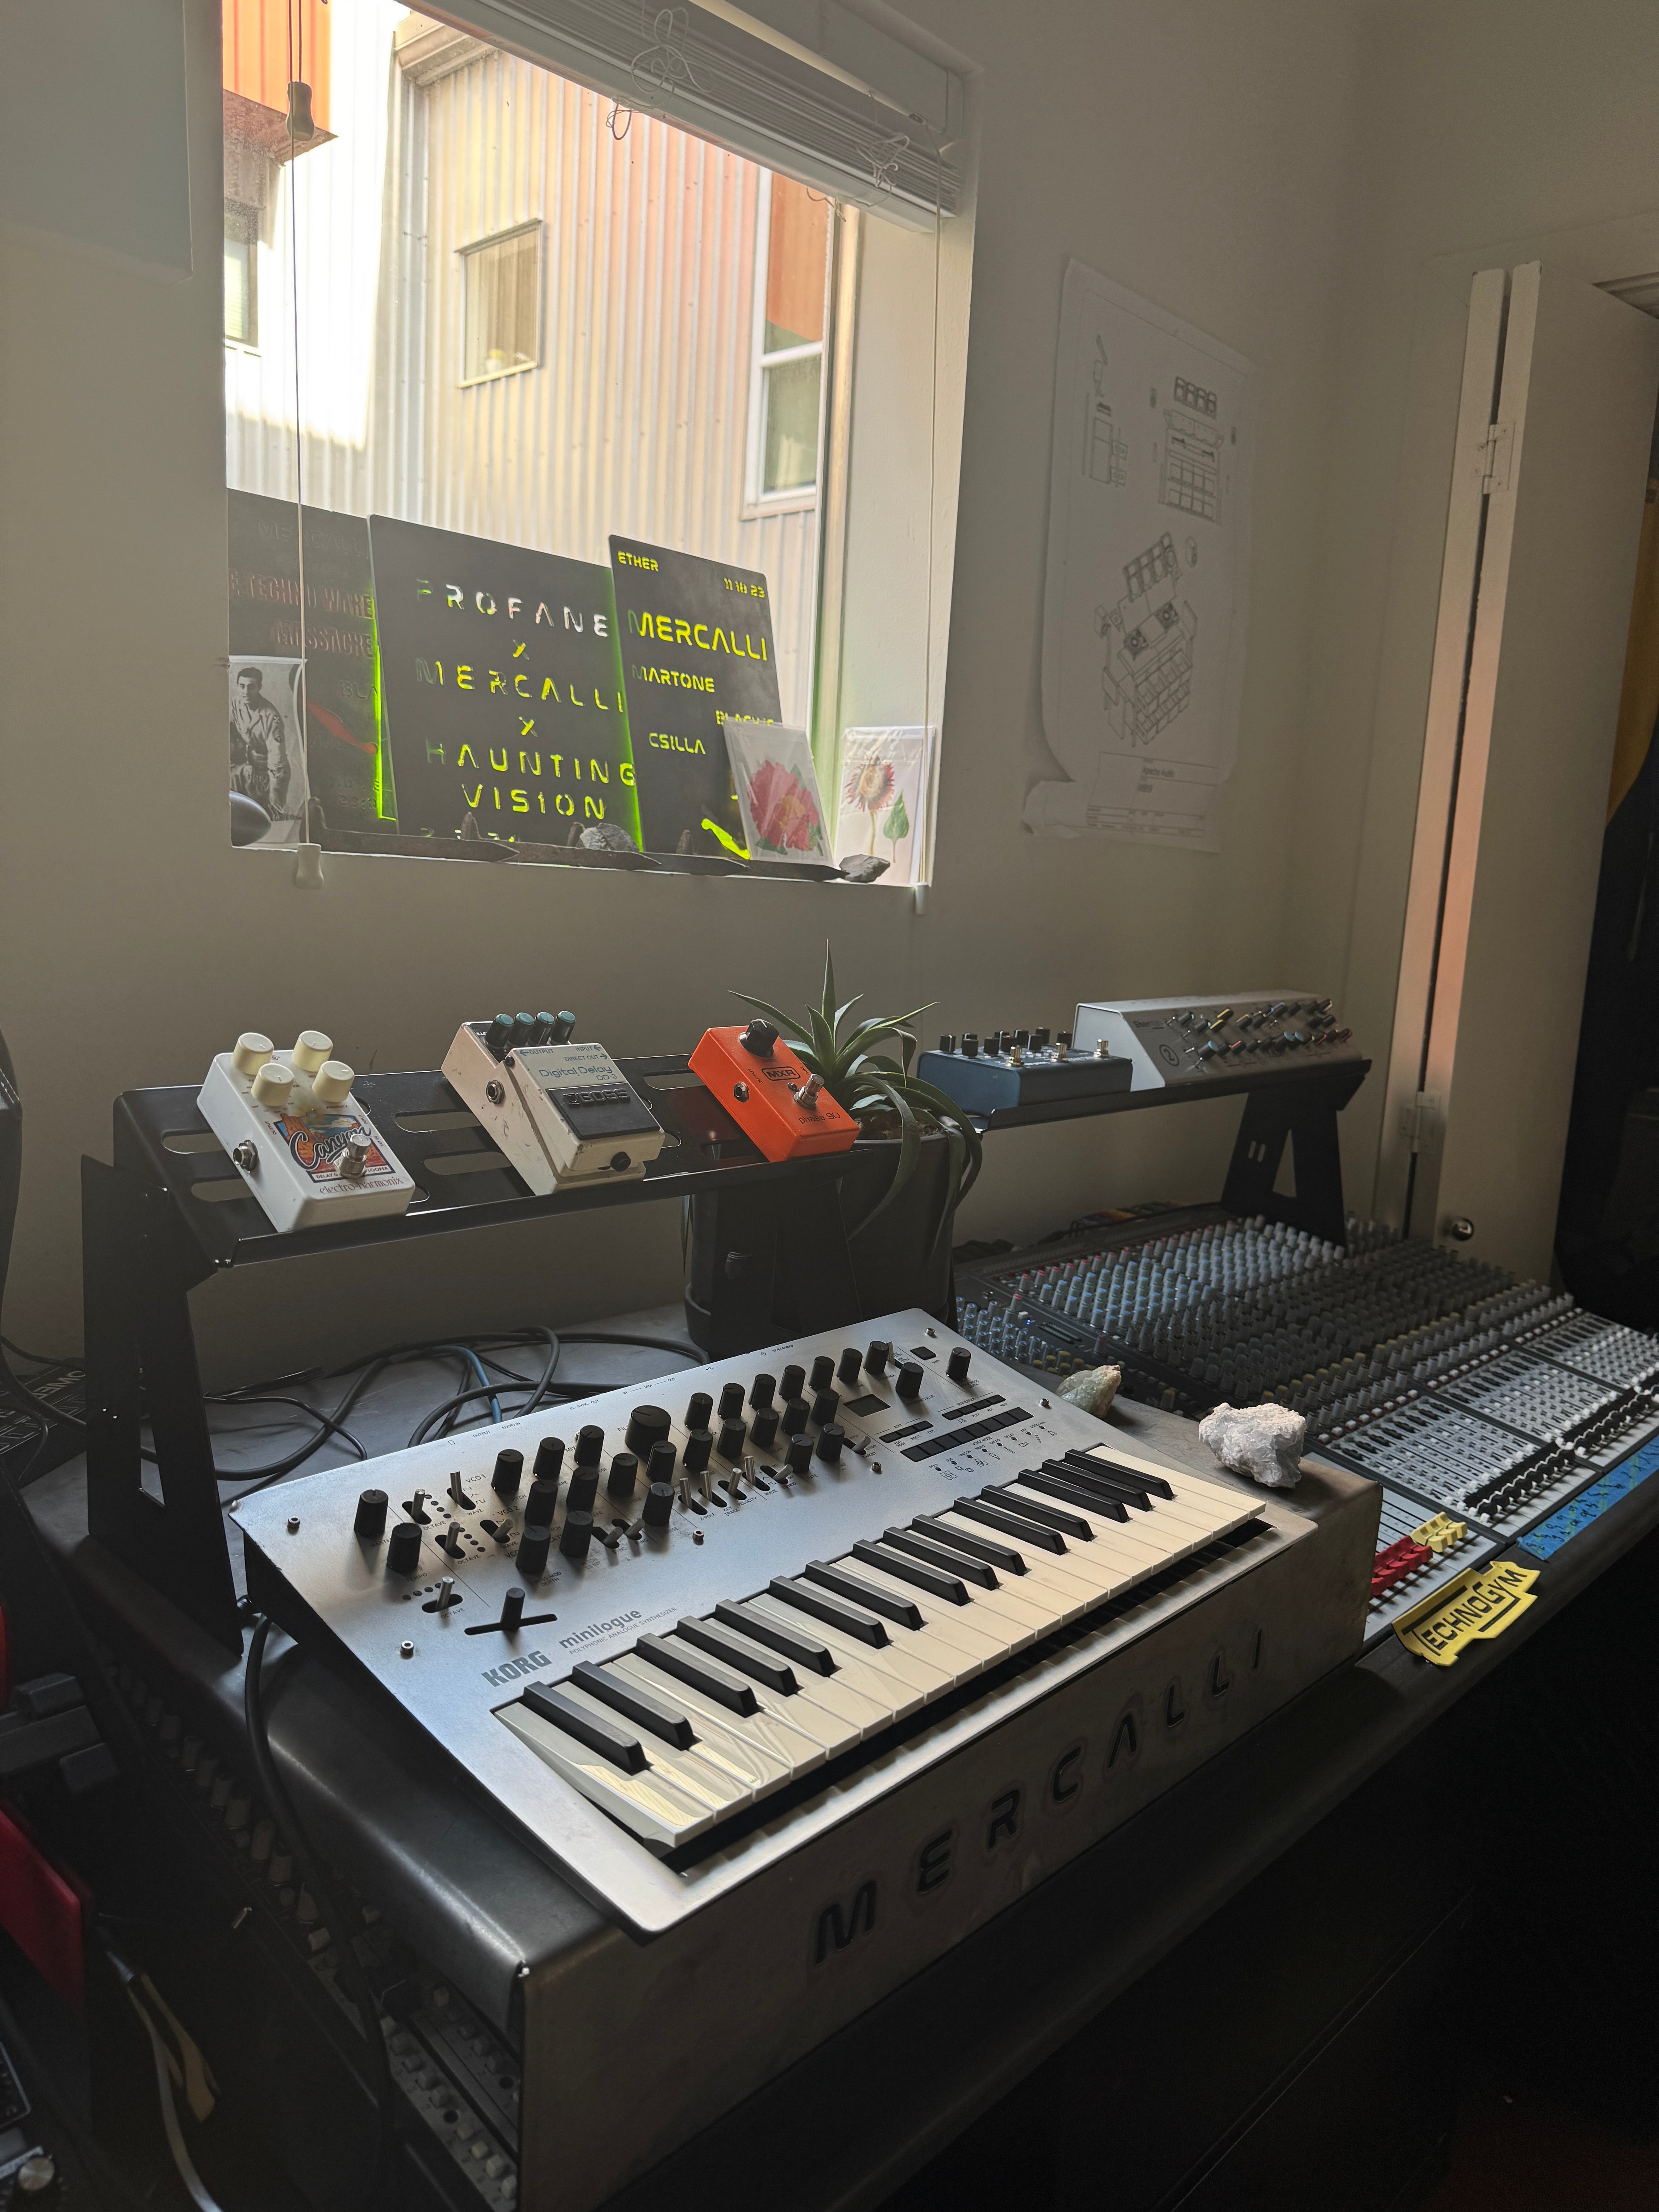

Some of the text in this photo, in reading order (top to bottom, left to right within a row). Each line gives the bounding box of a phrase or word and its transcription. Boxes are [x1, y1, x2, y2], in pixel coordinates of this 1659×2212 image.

[617, 551, 659, 572] ETHER
[723, 577, 733, 591] 11
[750, 584, 765, 599] 23
[416, 578, 610, 637] PROFANE
[627, 609, 768, 661] MERCALLI
[416, 657, 624, 713] MERCALLI
[632, 665, 715, 693] MARTONE
[649, 732, 706, 755] CSILLA
[426, 739, 637, 787] HAUNTING
[461, 783, 606, 820] VISION
[539, 1065, 613, 1078] Digital Delay
[596, 1073, 617, 1081] DD-3
[766, 1069, 796, 1078] MXR
[576, 1088, 630, 1104] BOSS
[799, 1115, 825, 1125] phase
[319, 1176, 404, 1194] electro-harmonix
[465, 1475, 482, 1484] VCO
[497, 1508, 514, 1516] VCO
[423, 1520, 447, 1530] OCTAVE
[369, 1538, 392, 1547] MASTE
[457, 1554, 481, 1565] OCTAVE
[440, 1607, 465, 1620] OCTAVE
[558, 1610, 643, 1649] minilogue
[569, 1606, 678, 1655] POLYPHONIC ANALOGUE SYNTHESIZER
[481, 1650, 553, 1687] KORG
[815, 1628, 1263, 1967] MERCALLI
